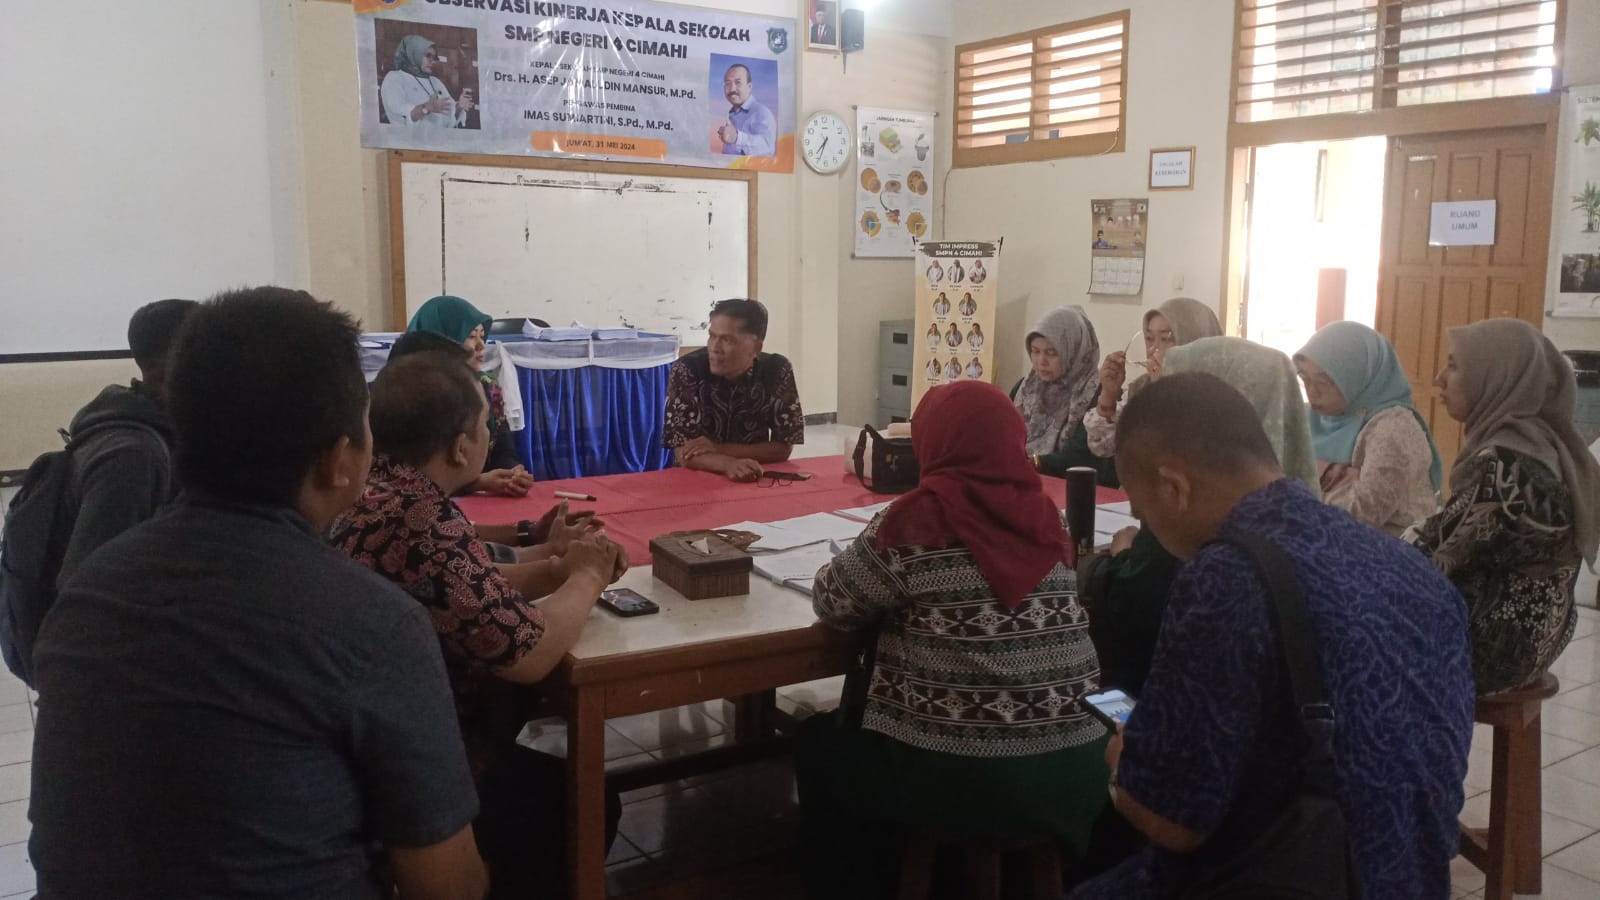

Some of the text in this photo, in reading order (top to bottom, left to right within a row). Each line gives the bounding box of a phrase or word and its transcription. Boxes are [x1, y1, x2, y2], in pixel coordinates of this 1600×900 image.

[425, 0, 750, 41] ERVASI KINERJA KEPALA SEKOLAH
[504, 25, 544, 42] SMP
[548, 30, 608, 49] NEGERI
[626, 39, 687, 59] CIMAHI
[641, 71, 665, 81] CIMAHI
[494, 72, 516, 82] Drs.
[518, 73, 530, 84] H.
[532, 75, 558, 85] ASEP
[622, 83, 669, 98] MANSUR,
[670, 88, 696, 100] M.Pd.
[606, 102, 636, 112] PEMBINA
[524, 110, 550, 121] IMAS
[617, 117, 644, 130] S.Pd.,
[646, 120, 674, 131] M.Pd.
[595, 140, 604, 148] 31
[606, 141, 618, 149] MEI
[620, 142, 636, 150] 2024
[1451, 222, 1478, 231] UMUM
